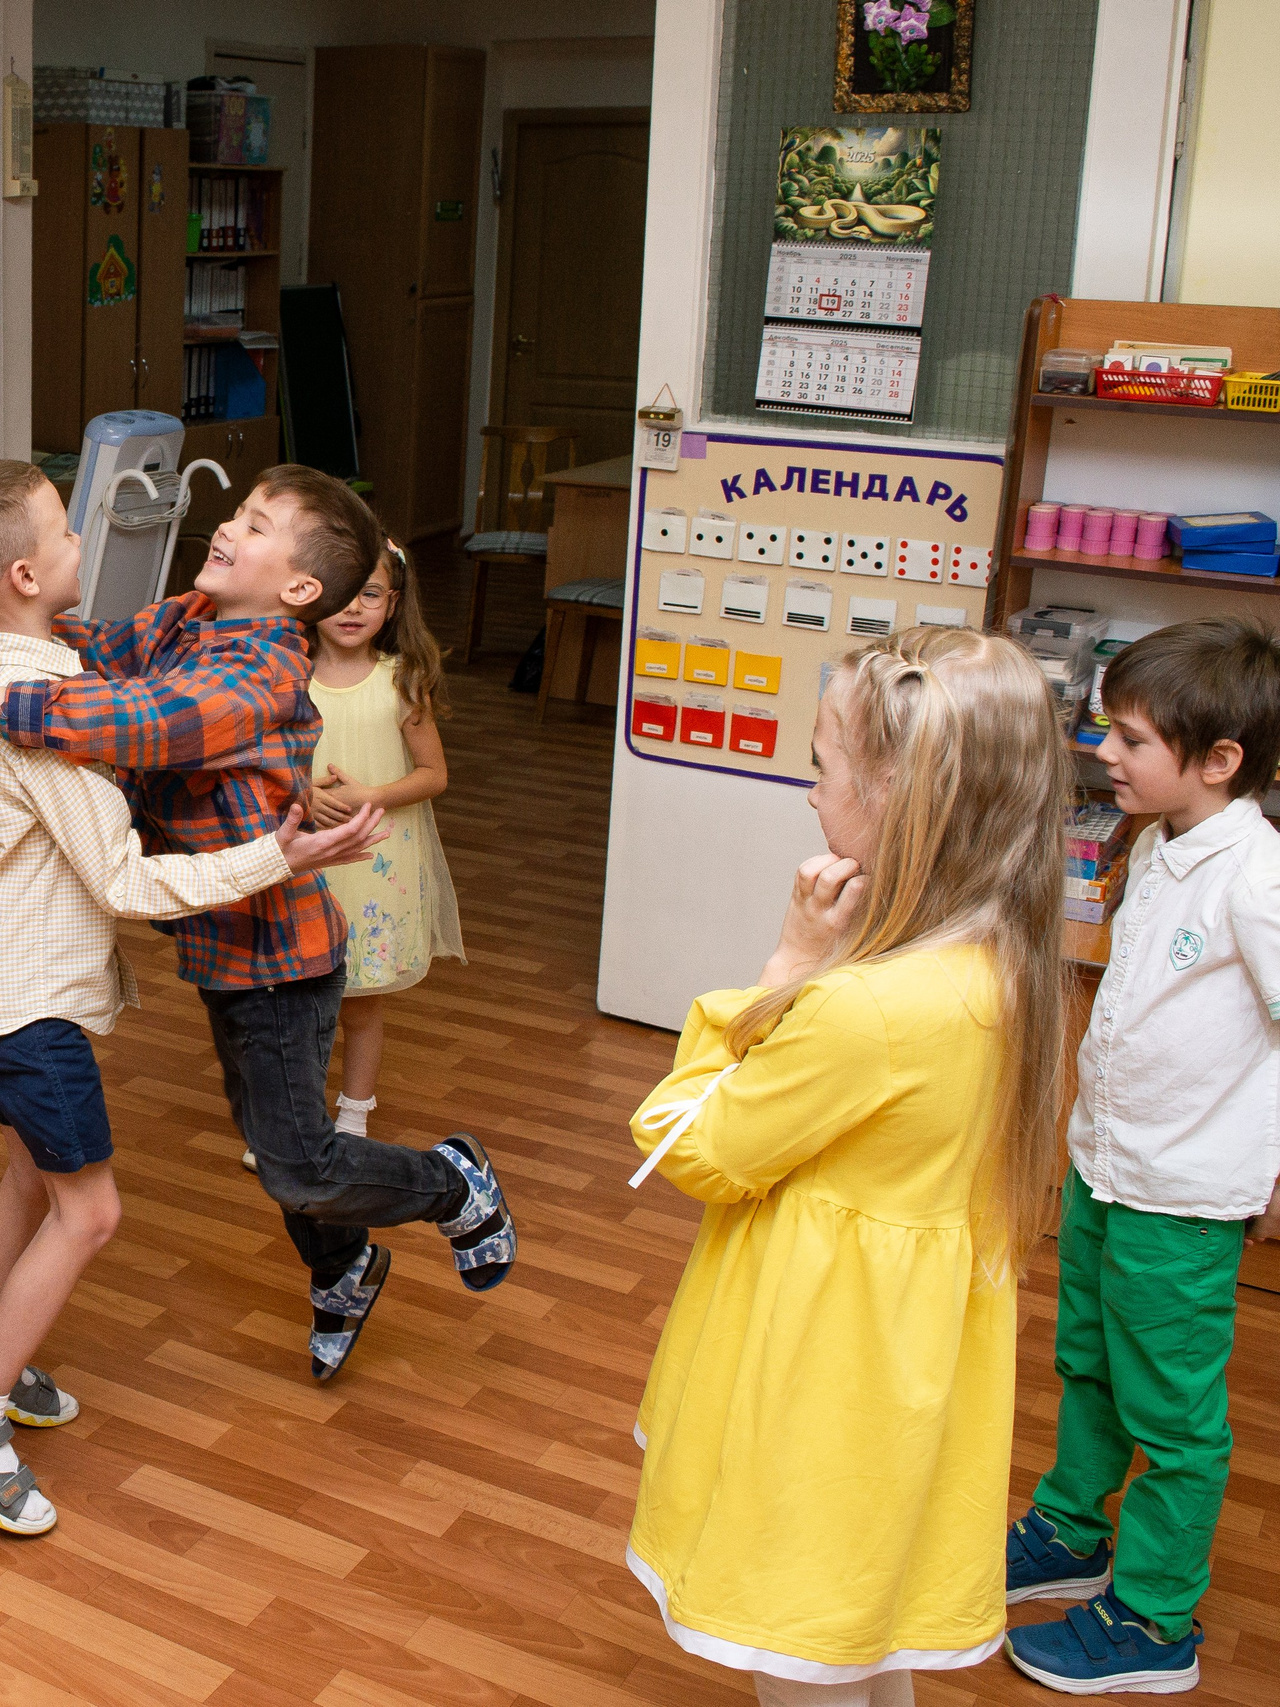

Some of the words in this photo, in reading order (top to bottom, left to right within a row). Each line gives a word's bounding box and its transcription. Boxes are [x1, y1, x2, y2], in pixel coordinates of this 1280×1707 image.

[847, 151, 876, 163] 2025
[654, 432, 671, 447] 19
[720, 466, 968, 522] КАЛЕНДАРЬ
[1093, 1601, 1114, 1627] Lassie
